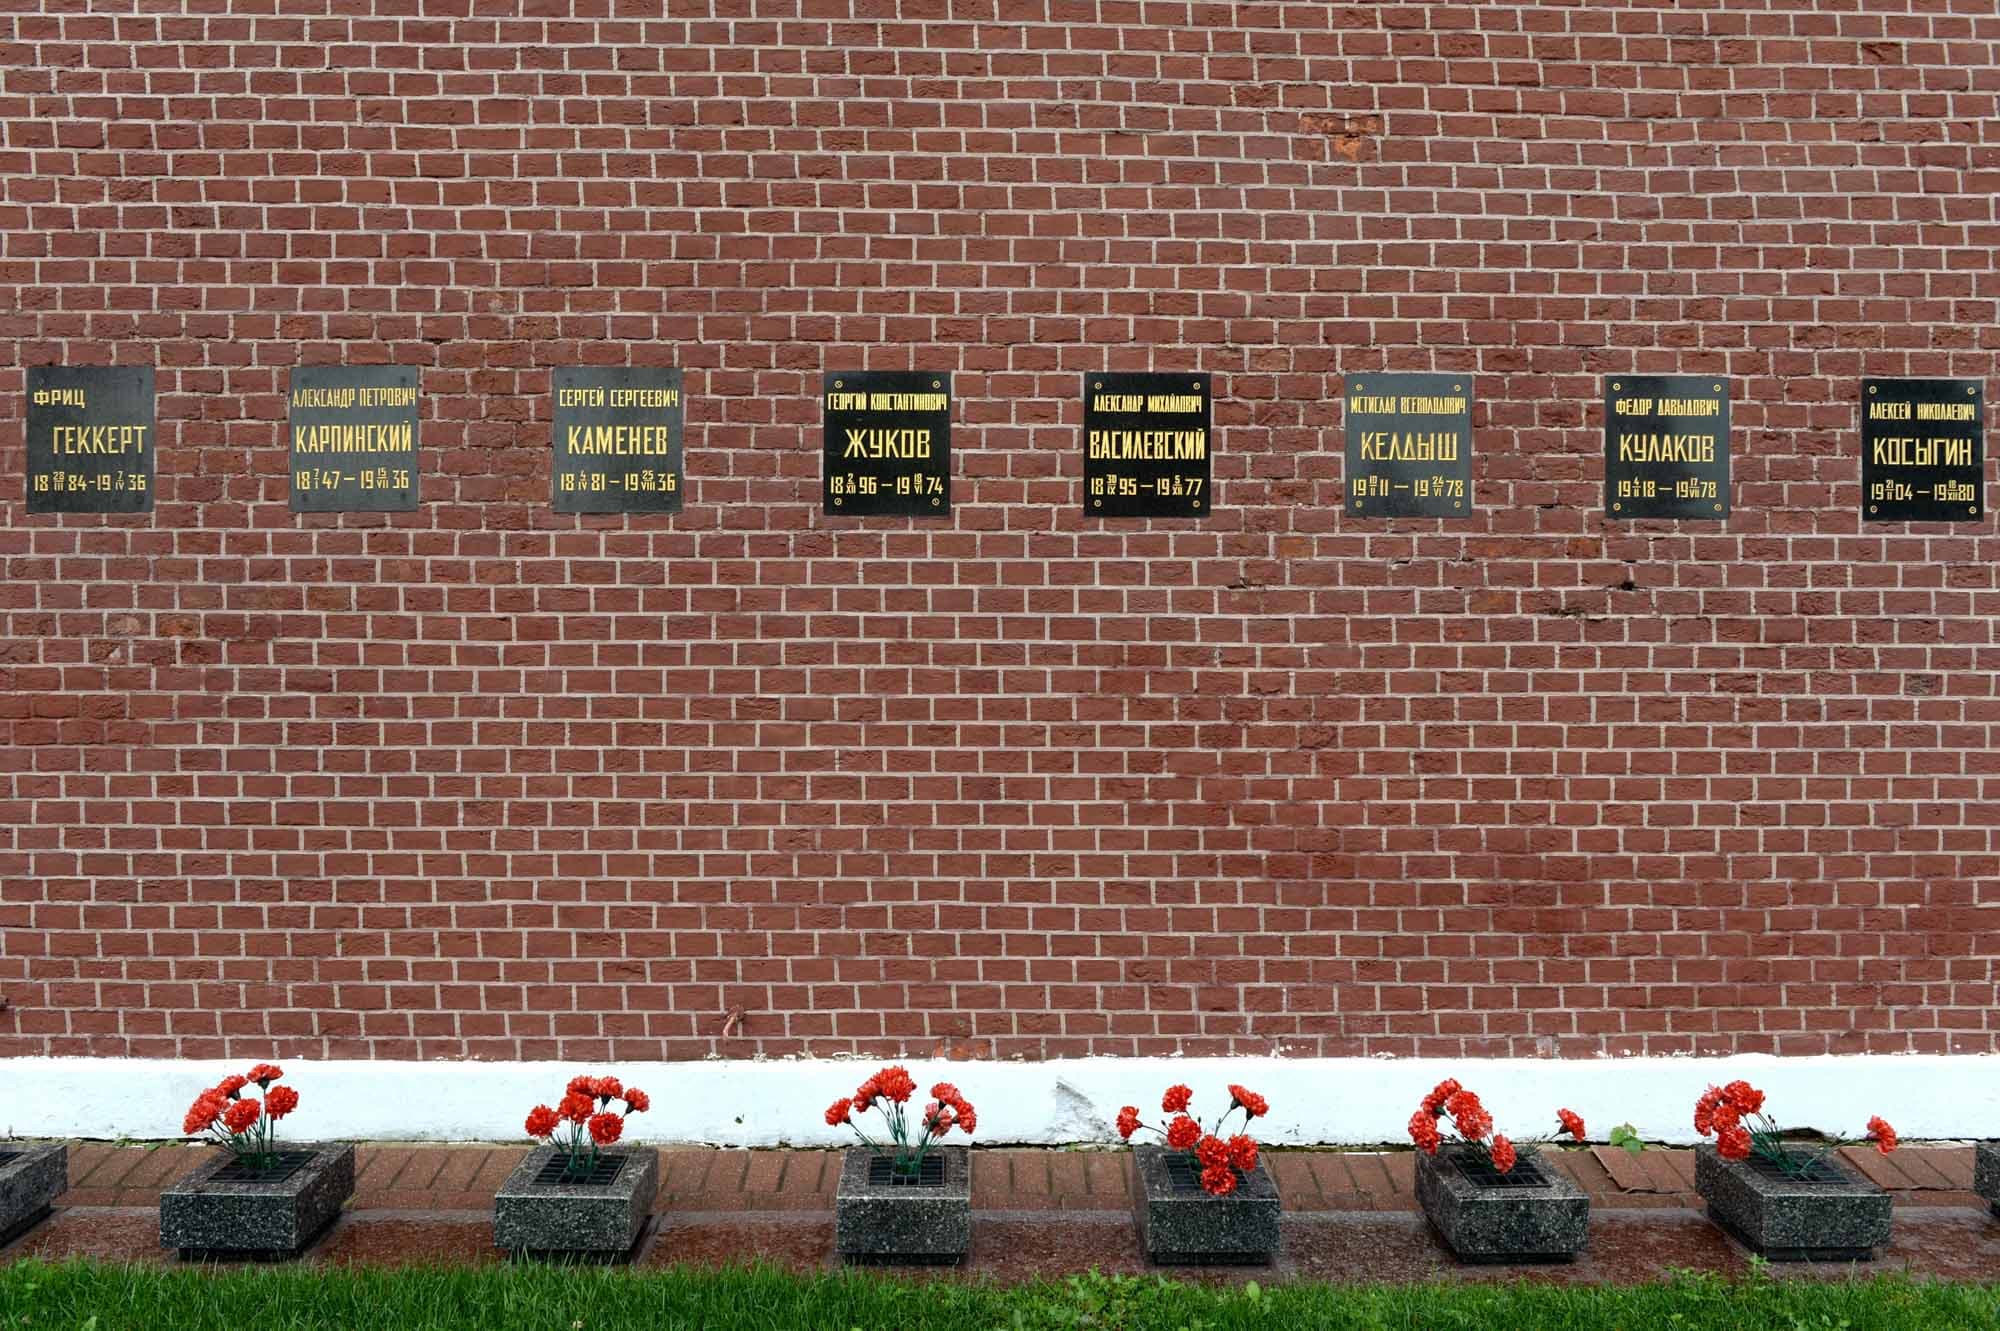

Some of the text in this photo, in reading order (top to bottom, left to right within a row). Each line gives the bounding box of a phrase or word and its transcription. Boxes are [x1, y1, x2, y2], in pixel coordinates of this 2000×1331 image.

[34, 389, 85, 408] ФРИЦ
[293, 387, 415, 408] АЛЕКСАНДР ПЕТРОВИЧ
[560, 386, 678, 407] СЕРГЕЙ СЕРГЕЕВИЧ
[828, 392, 947, 411] ГЕОРГИЙ КОНСТАНТИНОВИЧ
[1094, 393, 1202, 413] АЛЕКСАНДР МИХАЙЛОВИЧ
[1351, 396, 1466, 414] МСТИСЛАВ ВСЕВОЛОДОВИЧ
[1616, 398, 1719, 416] ФЕДОР ДАВЫДОВИЧ
[1870, 401, 1975, 420] АЛЕКСЕЙ НИКОЛАЕВИЧ
[53, 426, 146, 454] ГЕККЕРТ
[296, 420, 411, 453] КАРПИНСКИЙ
[568, 426, 667, 455] КАМЕНЕВ
[844, 429, 930, 458] ЖУКОВ
[1090, 428, 1205, 459] ВАСИЛЕВСКИЙ
[1361, 432, 1457, 461] КЕЛДЫШ
[1620, 434, 1714, 462] КУЛАКОВ
[1874, 438, 1972, 465] КОСЫГИН
